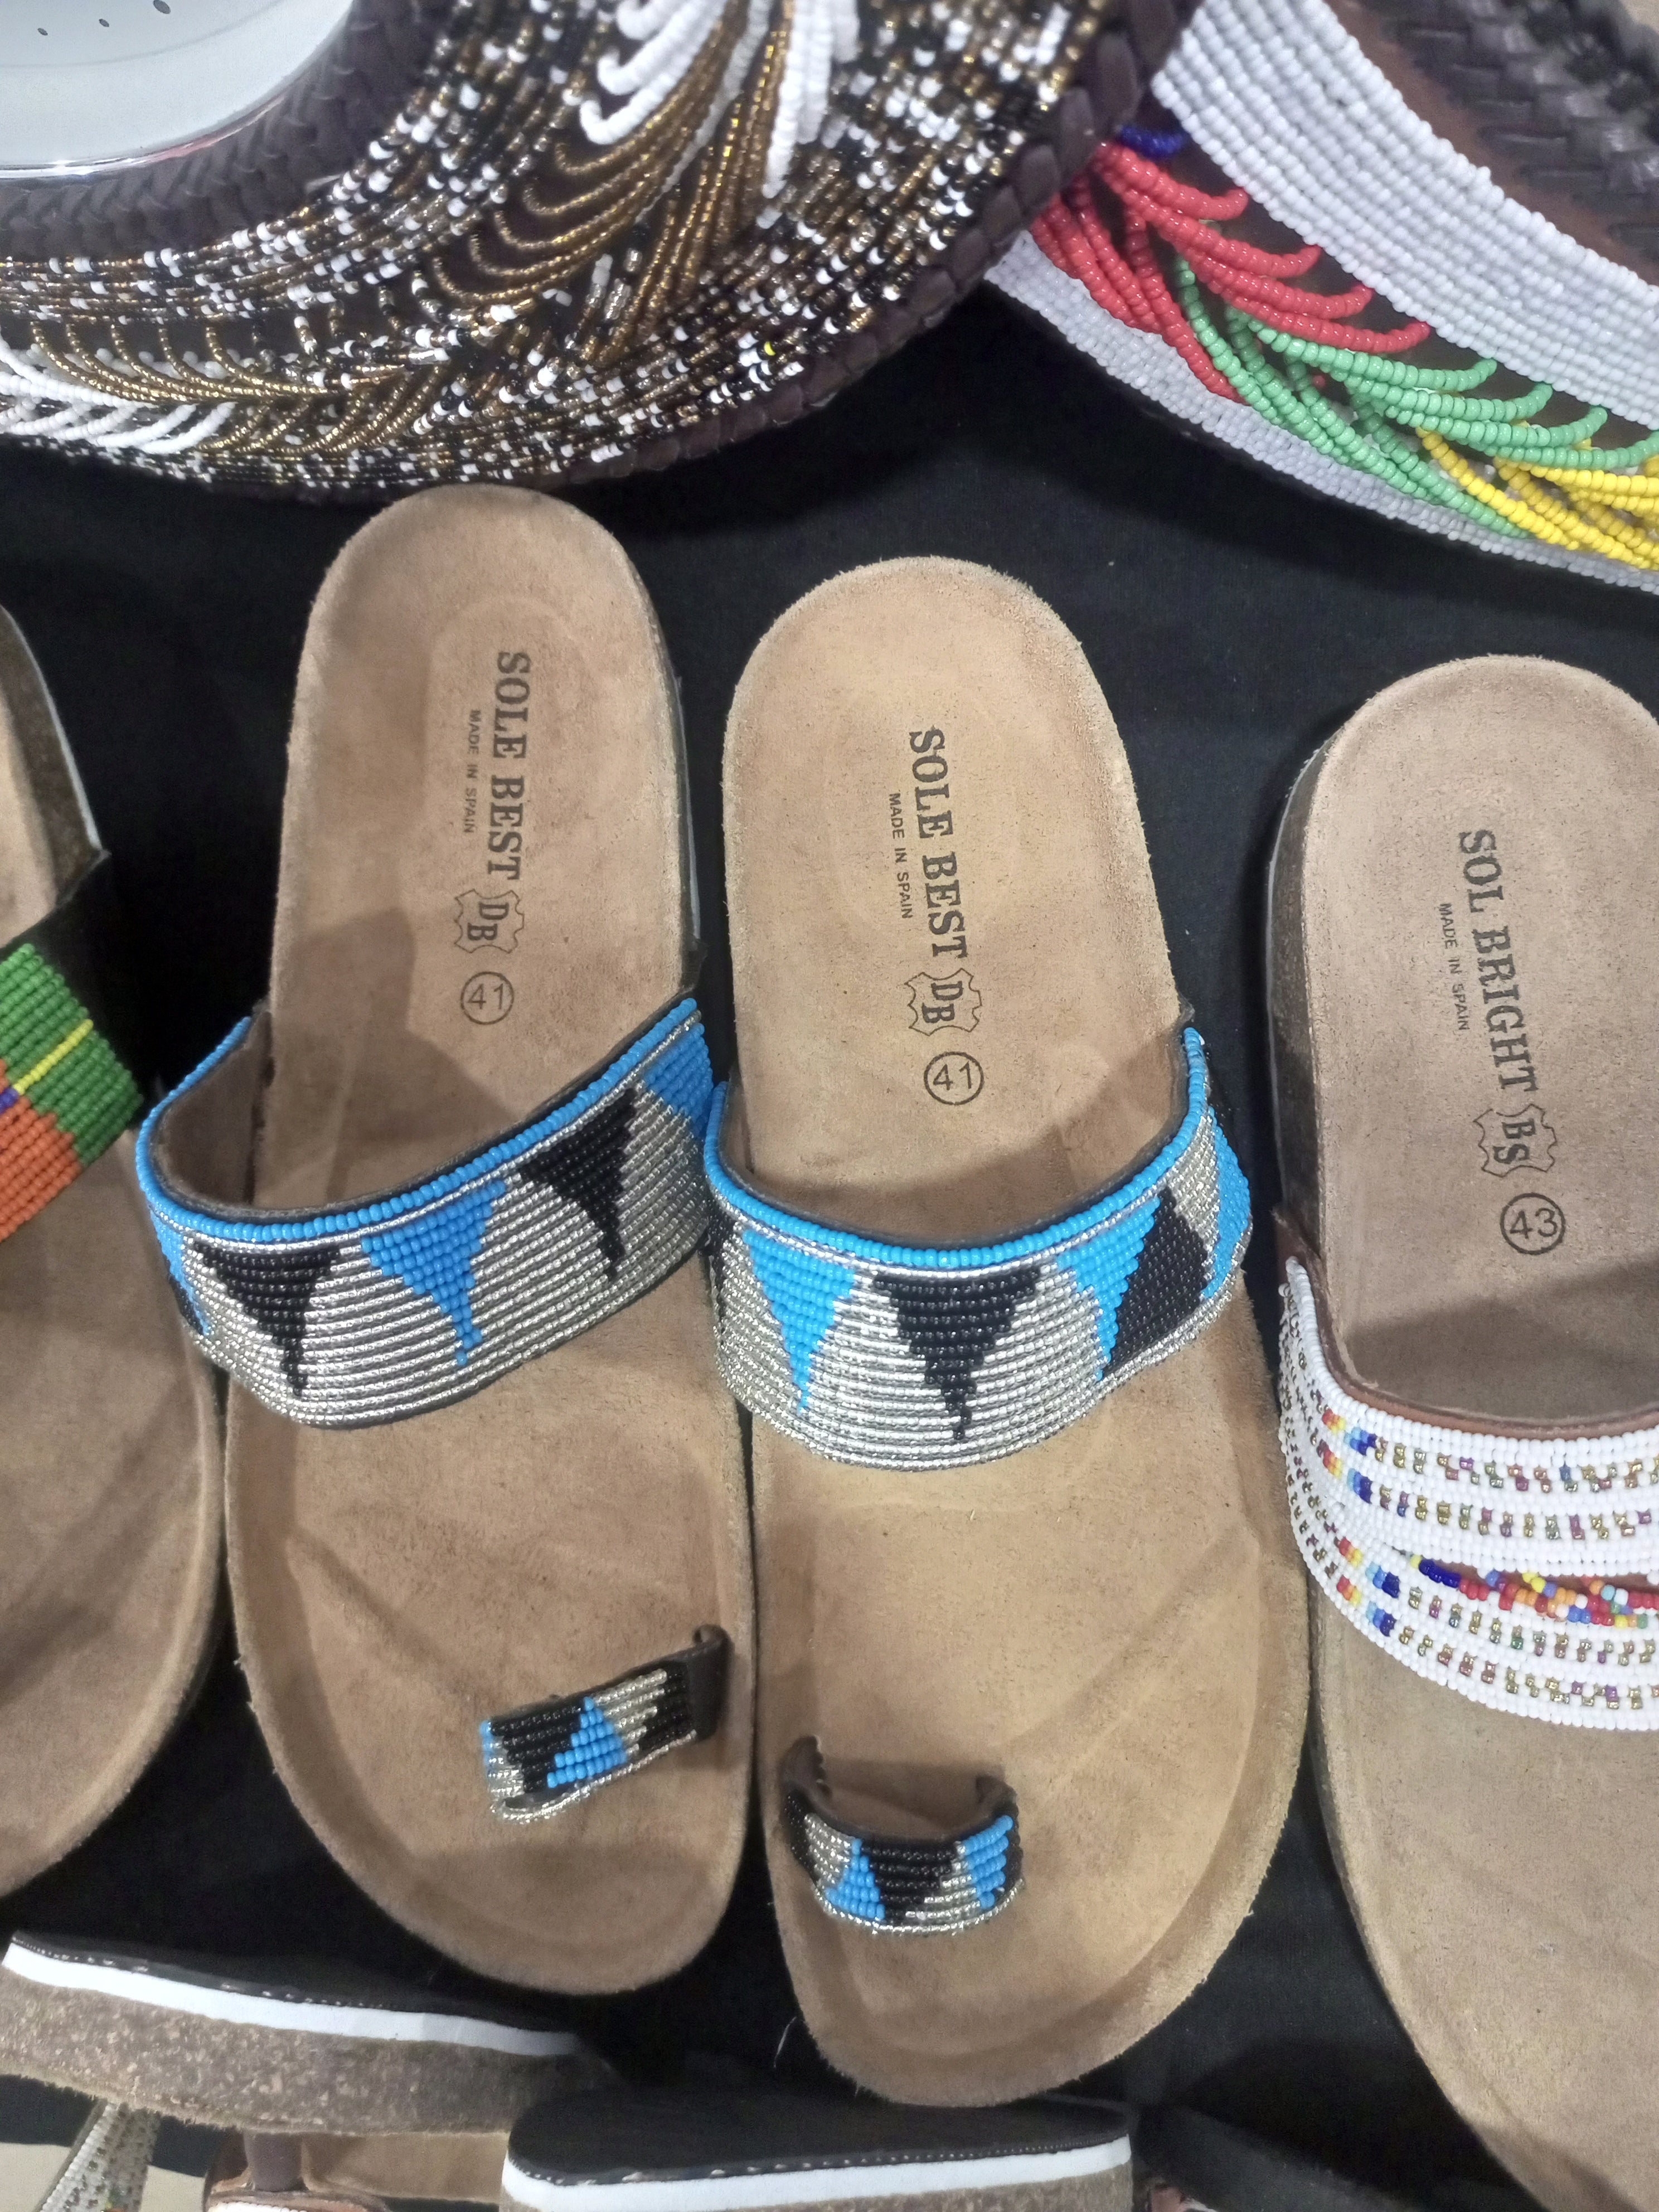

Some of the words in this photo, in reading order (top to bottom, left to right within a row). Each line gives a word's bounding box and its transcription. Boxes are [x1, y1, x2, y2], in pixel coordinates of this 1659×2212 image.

[493, 651, 532, 759] SOLE
[466, 709, 481, 755] MADE
[466, 764, 478, 779] IN
[909, 729, 954, 839] SOLE
[463, 788, 477, 834] SPAIN
[488, 775, 525, 880] BEST
[889, 792, 905, 839] MADE
[895, 846, 907, 863] IN
[1458, 829, 1505, 914] SOL
[897, 871, 913, 919] SPAIN
[922, 852, 968, 959] BEST
[467, 902, 509, 942] DB
[1439, 903, 1458, 949] MADE
[1449, 957, 1463, 974] IN
[468, 983, 503, 1010] 41
[921, 980, 964, 1023] DB
[1452, 981, 1469, 1031] SPAIN
[1472, 925, 1539, 1093] BRIGHT
[932, 1062, 973, 1090] 41
[1493, 1118, 1536, 1165] BS
[1508, 1208, 1559, 1238] 43
